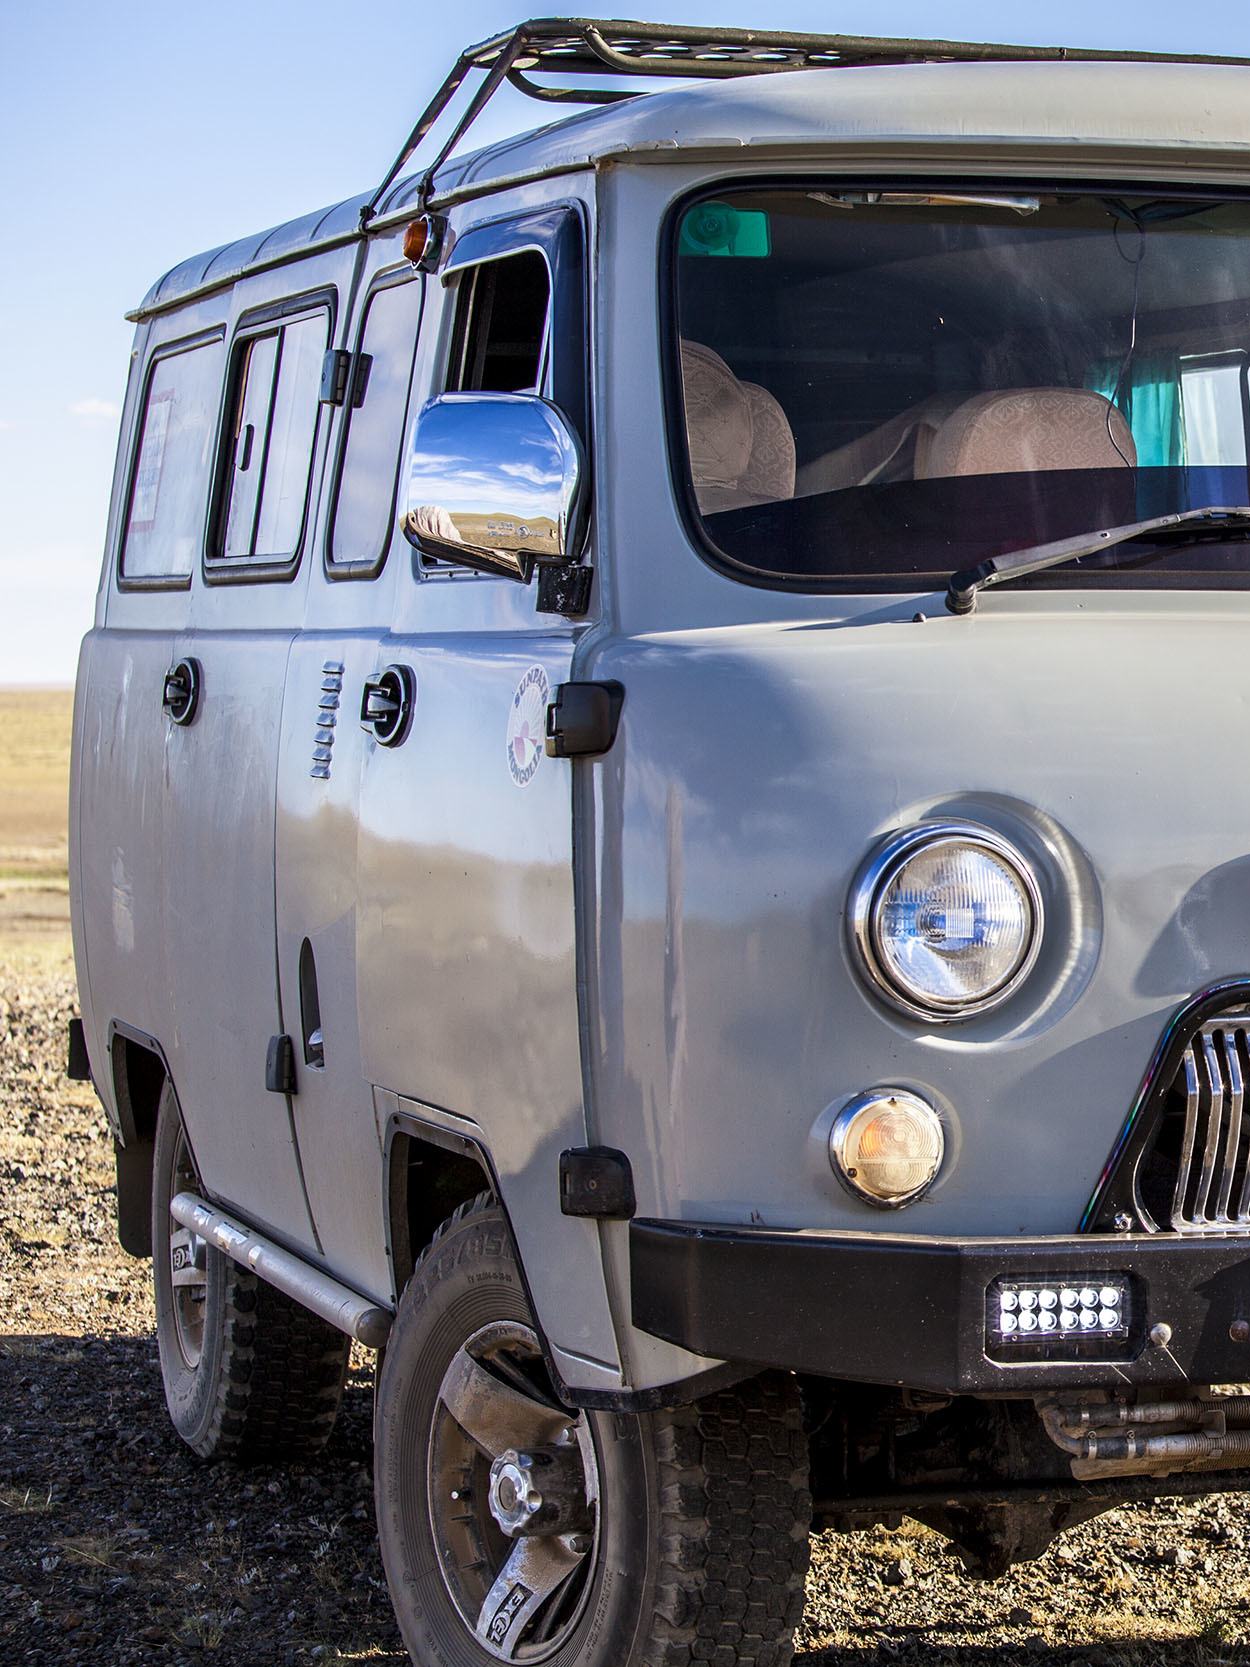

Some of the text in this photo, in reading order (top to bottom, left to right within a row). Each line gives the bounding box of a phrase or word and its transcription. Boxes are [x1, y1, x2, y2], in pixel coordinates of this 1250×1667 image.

[514, 668, 549, 707] SUNPATH
[508, 740, 542, 785] MONGOLIA
[491, 1590, 525, 1642] EXCEL
